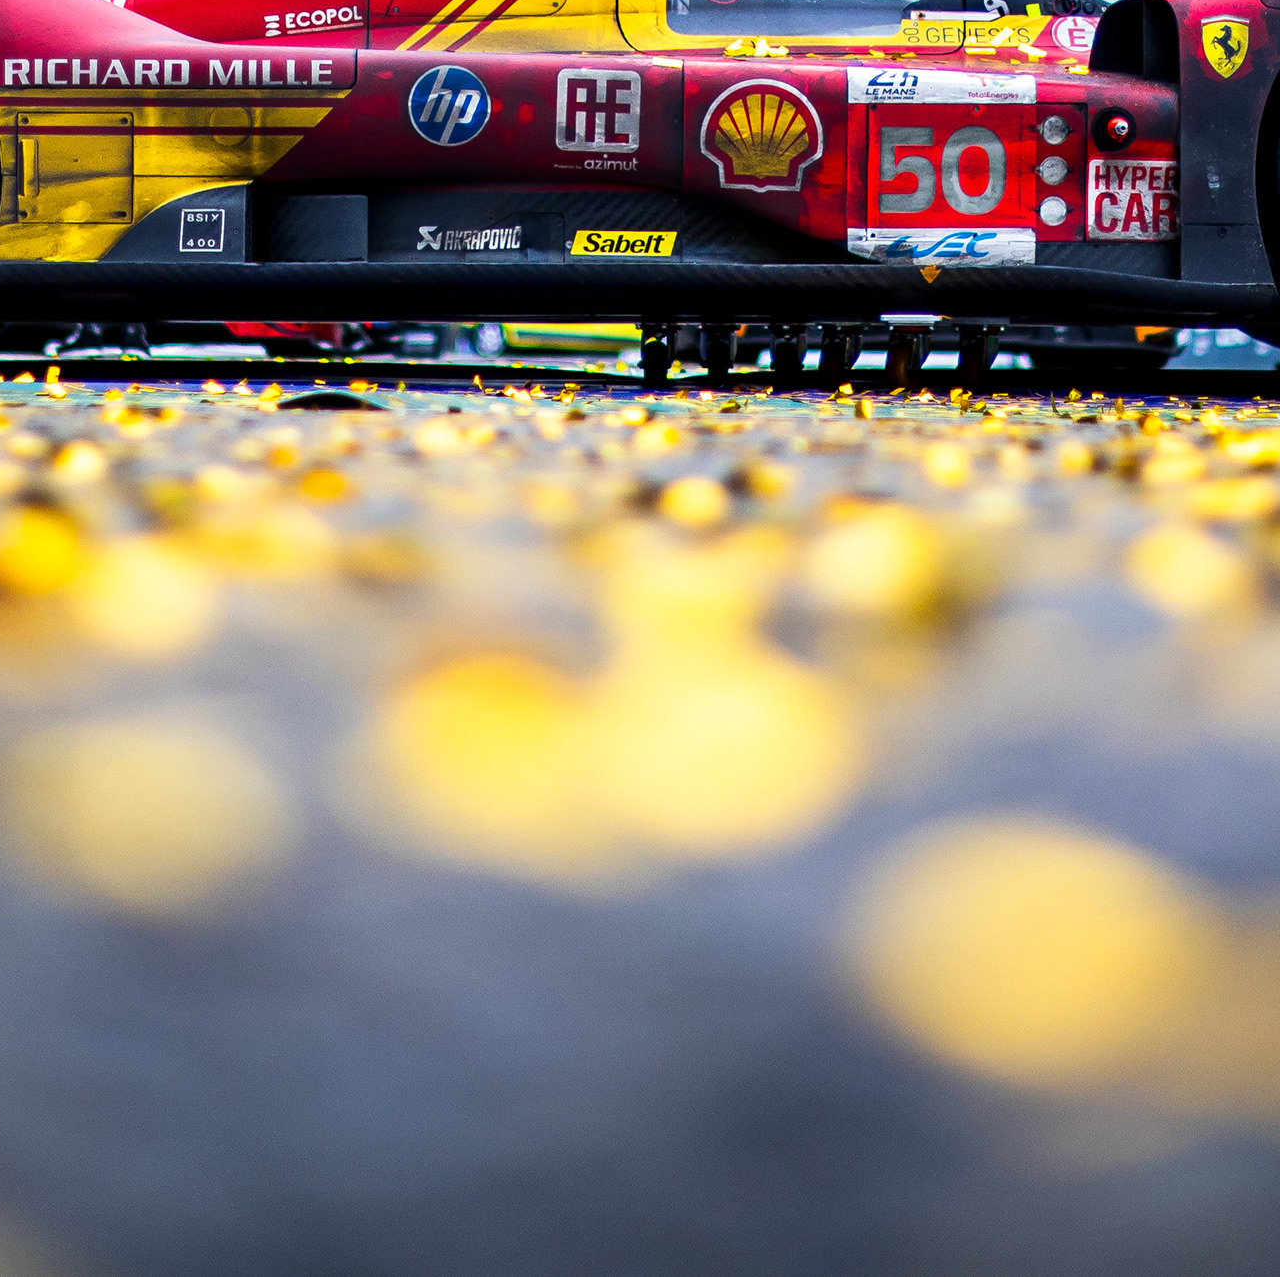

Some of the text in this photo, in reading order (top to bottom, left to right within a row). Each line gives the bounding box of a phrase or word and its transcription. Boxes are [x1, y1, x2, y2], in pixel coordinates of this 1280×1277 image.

[284, 5, 363, 29] ECOPOL
[3, 58, 333, 86] RICHARD MILLE
[864, 88, 917, 97] LE MANS
[966, 91, 1019, 100] TotalEnergies
[419, 67, 482, 144] hp
[583, 153, 639, 172] azimut
[879, 126, 1007, 215] 50
[1094, 192, 1179, 233] CAR
[186, 238, 216, 249] 400
[582, 232, 665, 254] Sabelt
[885, 231, 998, 259] WEC
